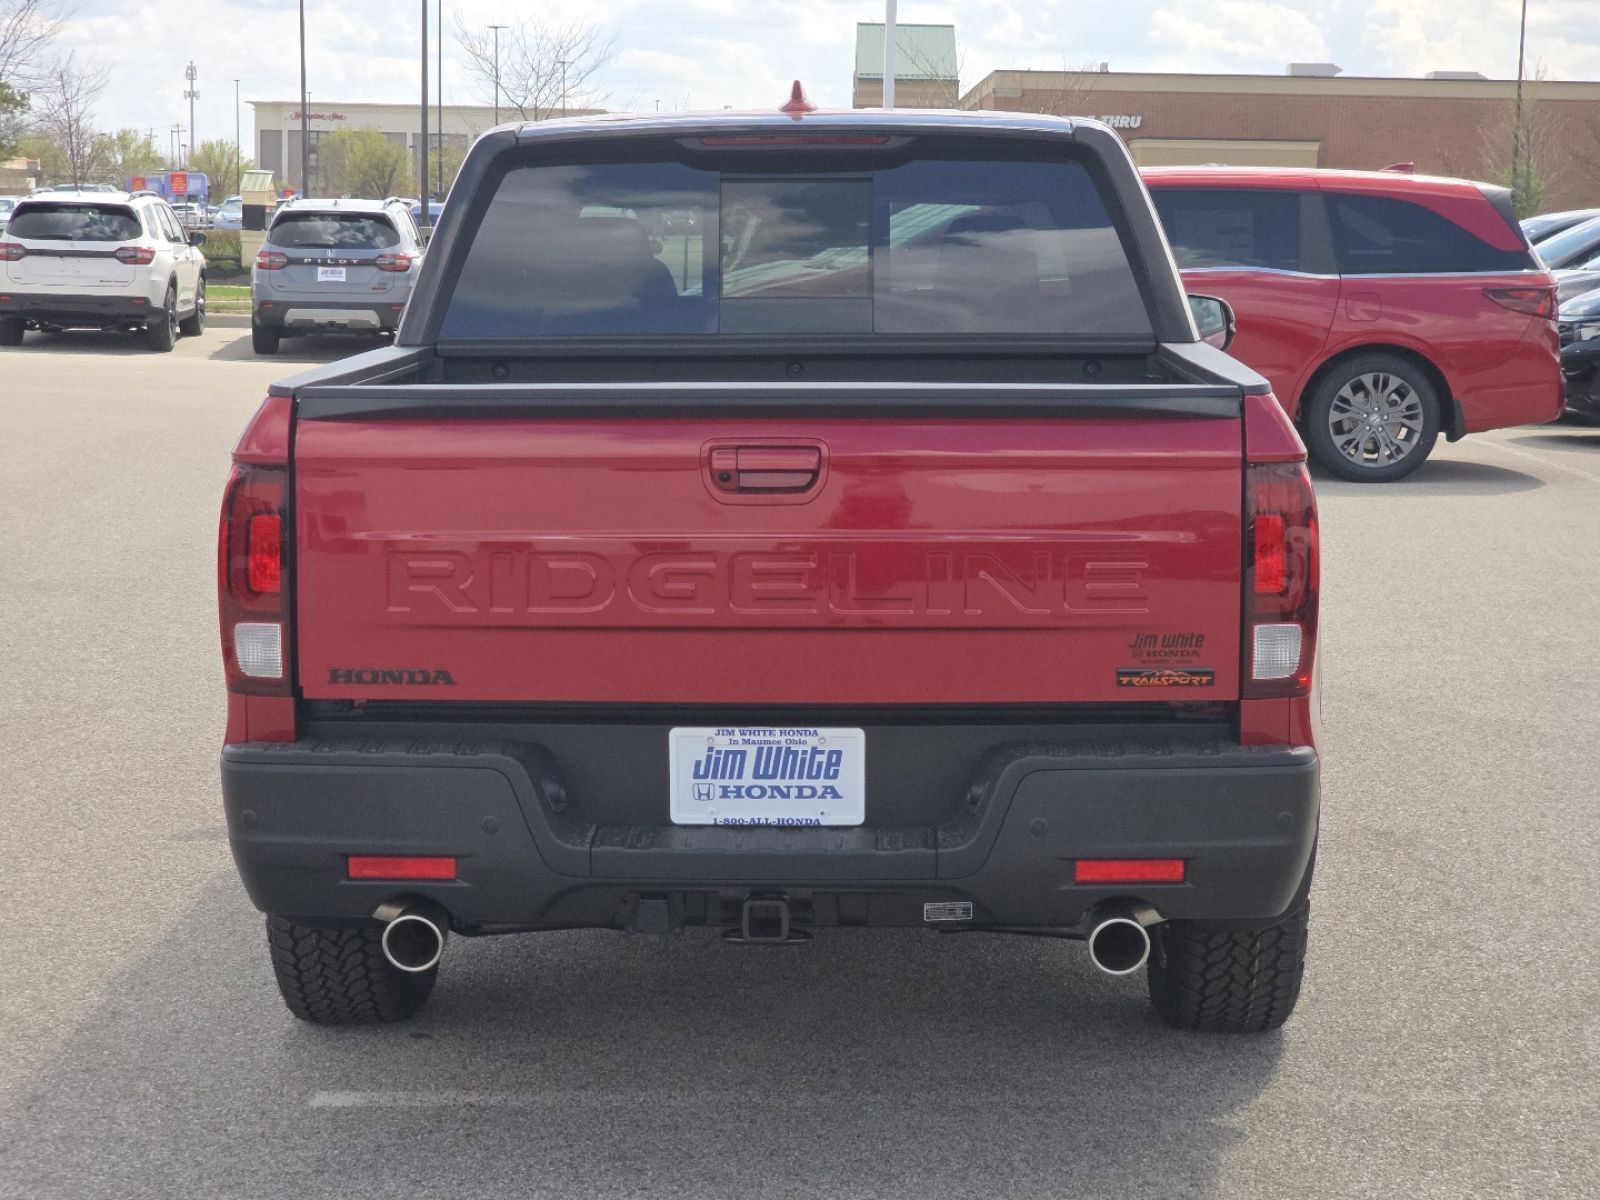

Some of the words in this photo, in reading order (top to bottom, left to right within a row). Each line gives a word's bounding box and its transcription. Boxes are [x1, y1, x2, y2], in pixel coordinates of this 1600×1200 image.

[1101, 115, 1141, 128] THRU
[386, 550, 1149, 615] RIDGELINE
[1145, 649, 1200, 657] HONDA
[328, 669, 457, 684] HONDA
[1119, 675, 1212, 686] TRAILSPORT
[714, 729, 735, 737] JIM
[738, 729, 776, 737] WHITE
[778, 729, 819, 737] HONDA
[742, 738, 782, 746] Maumee
[784, 738, 808, 746] Ohio
[752, 746, 843, 780] White
[718, 785, 843, 800] HONDA
[713, 817, 821, 826] 1-800-ALL-HONDA
